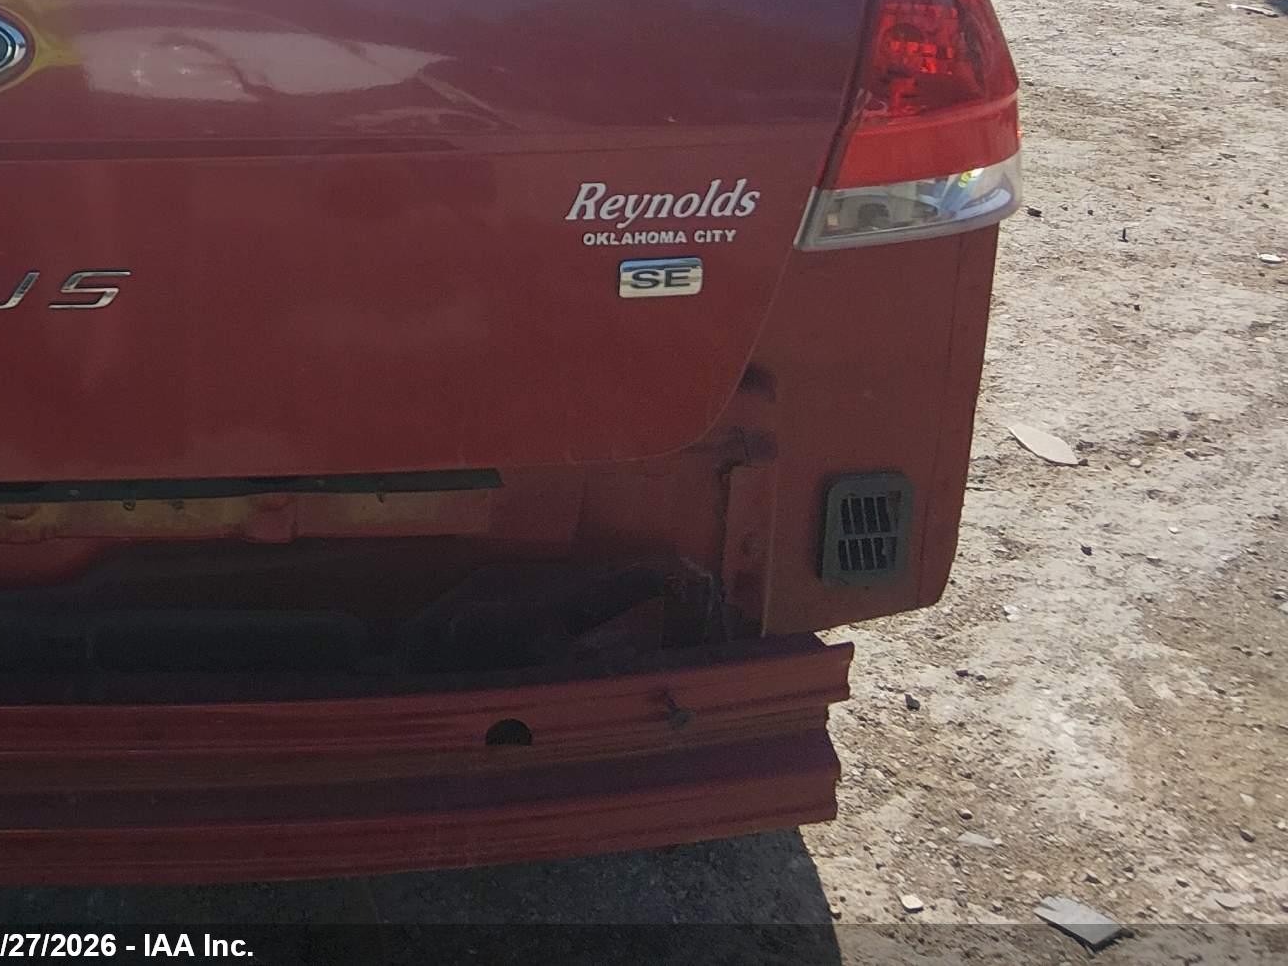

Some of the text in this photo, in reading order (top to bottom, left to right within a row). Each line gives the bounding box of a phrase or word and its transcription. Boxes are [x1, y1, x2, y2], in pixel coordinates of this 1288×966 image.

[565, 179, 760, 229] Reynolds
[583, 230, 736, 246] OKLAHOMA CITY
[630, 268, 692, 289] SE
